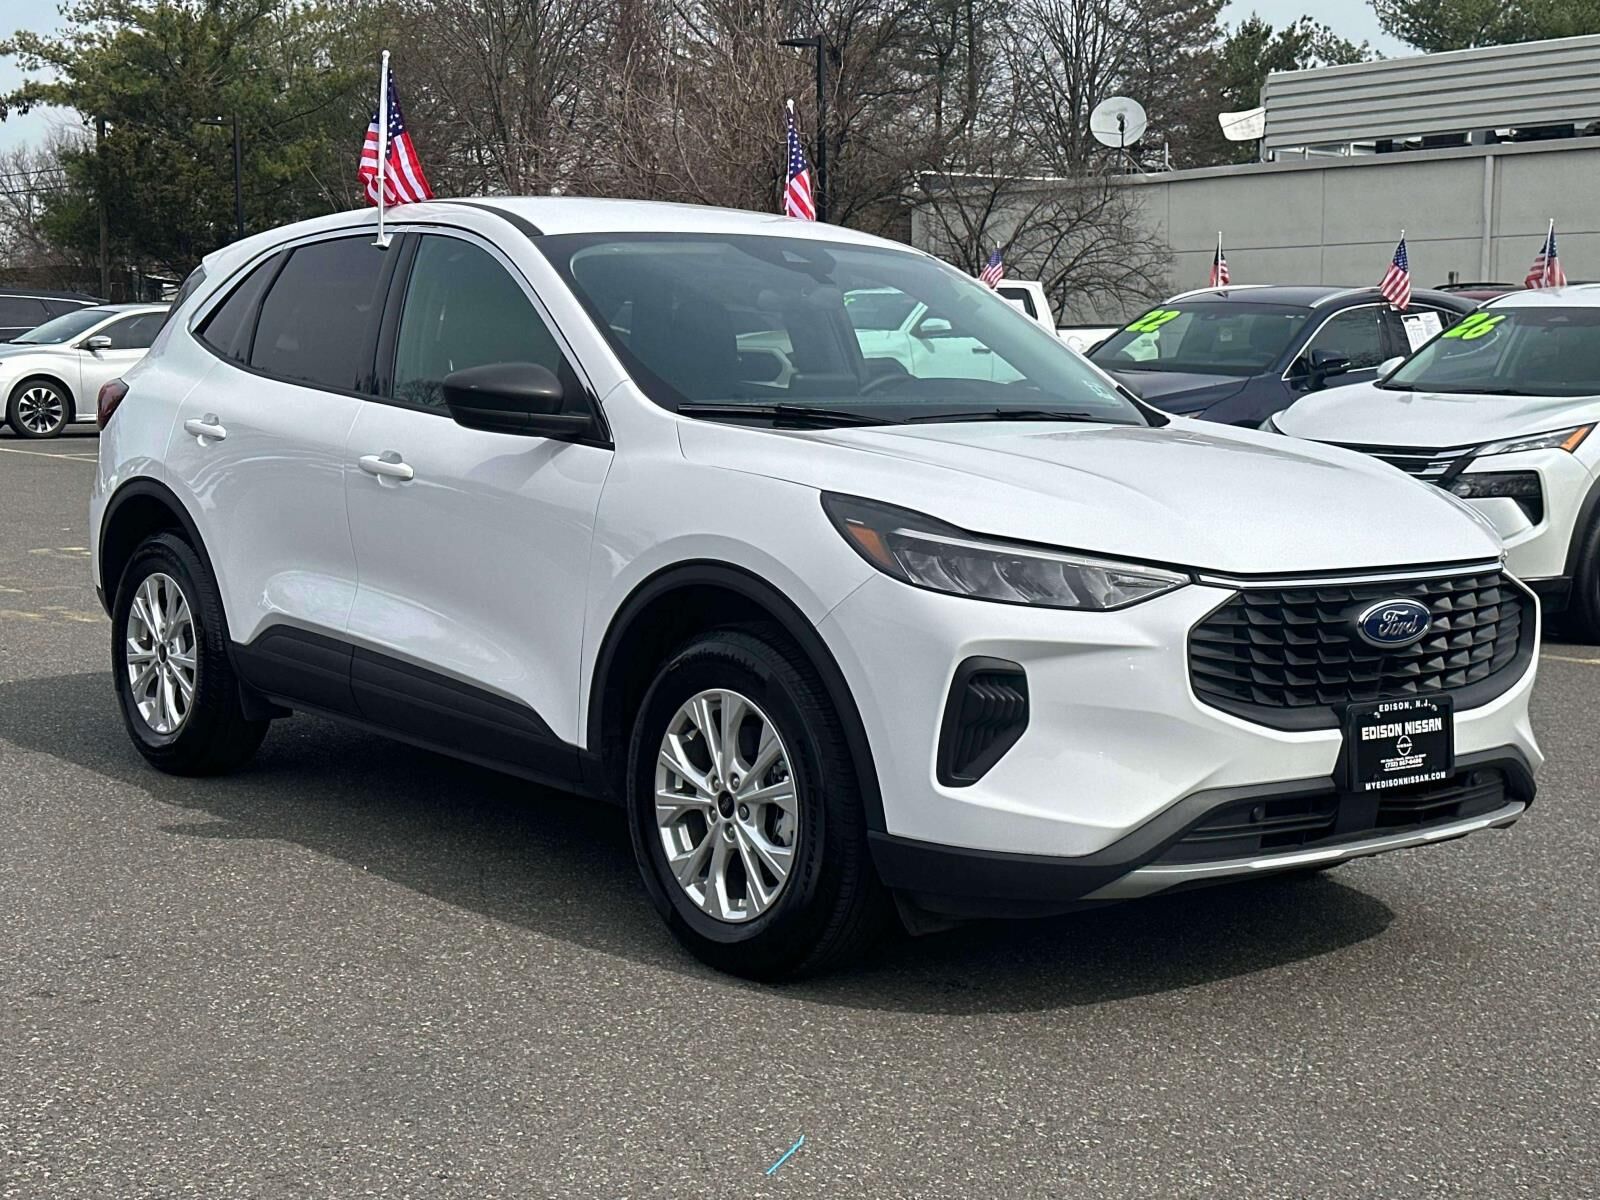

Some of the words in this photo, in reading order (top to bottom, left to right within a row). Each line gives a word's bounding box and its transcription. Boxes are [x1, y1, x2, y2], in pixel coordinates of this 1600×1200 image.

[1125, 311, 1181, 333] 22
[1442, 313, 1506, 340] 26
[1379, 609, 1419, 638] Ford
[1378, 701, 1413, 712] EDISON,
[1415, 698, 1431, 709] N.J.
[1361, 722, 1402, 741] EDISON
[1404, 717, 1442, 735] NISSAN
[1365, 771, 1446, 791] MYEDISONNISSAN.COM
